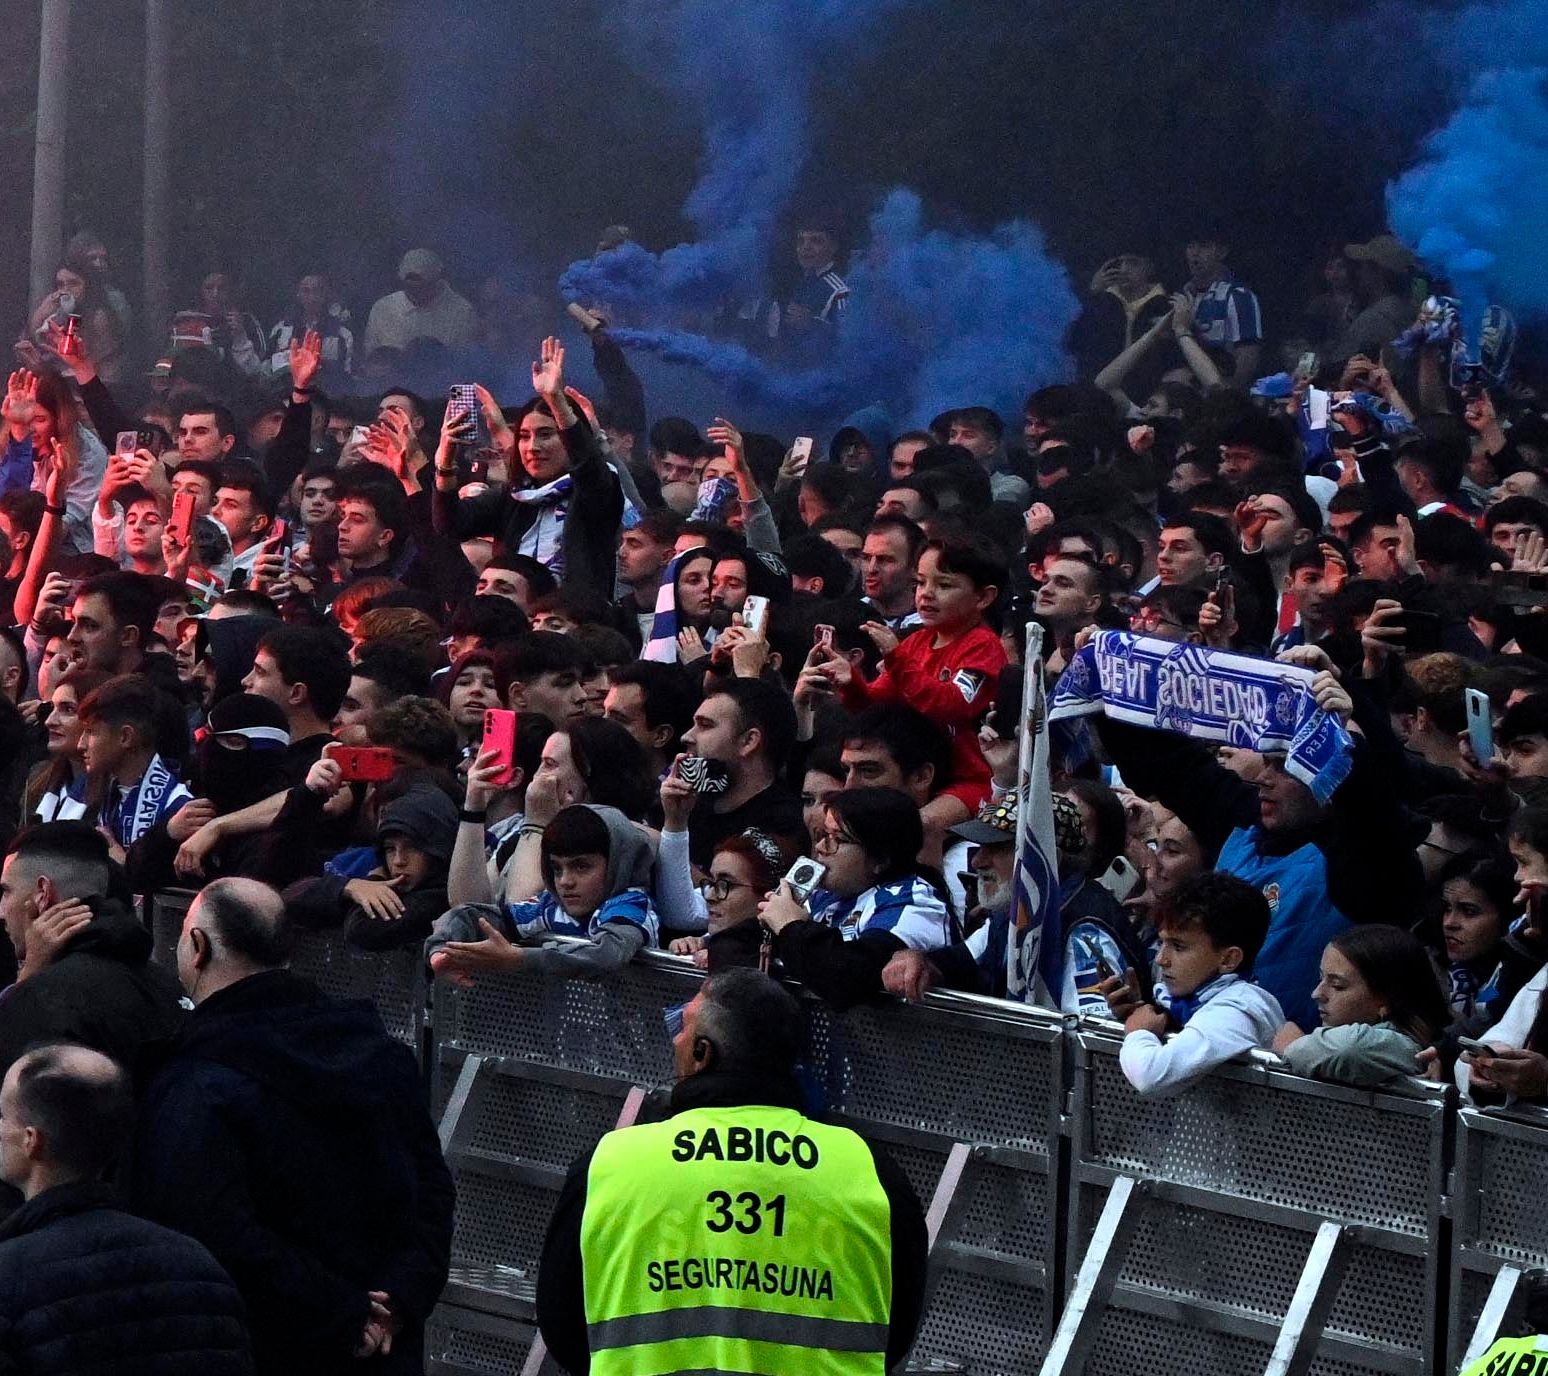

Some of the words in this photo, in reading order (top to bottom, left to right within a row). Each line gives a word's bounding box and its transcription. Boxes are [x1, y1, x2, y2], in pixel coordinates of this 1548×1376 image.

[1080, 1005, 1108, 1015] REAL
[671, 1126, 820, 1170] SABICO
[706, 1190, 787, 1237] 331
[648, 1257, 834, 1301] SEGURTASUNA
